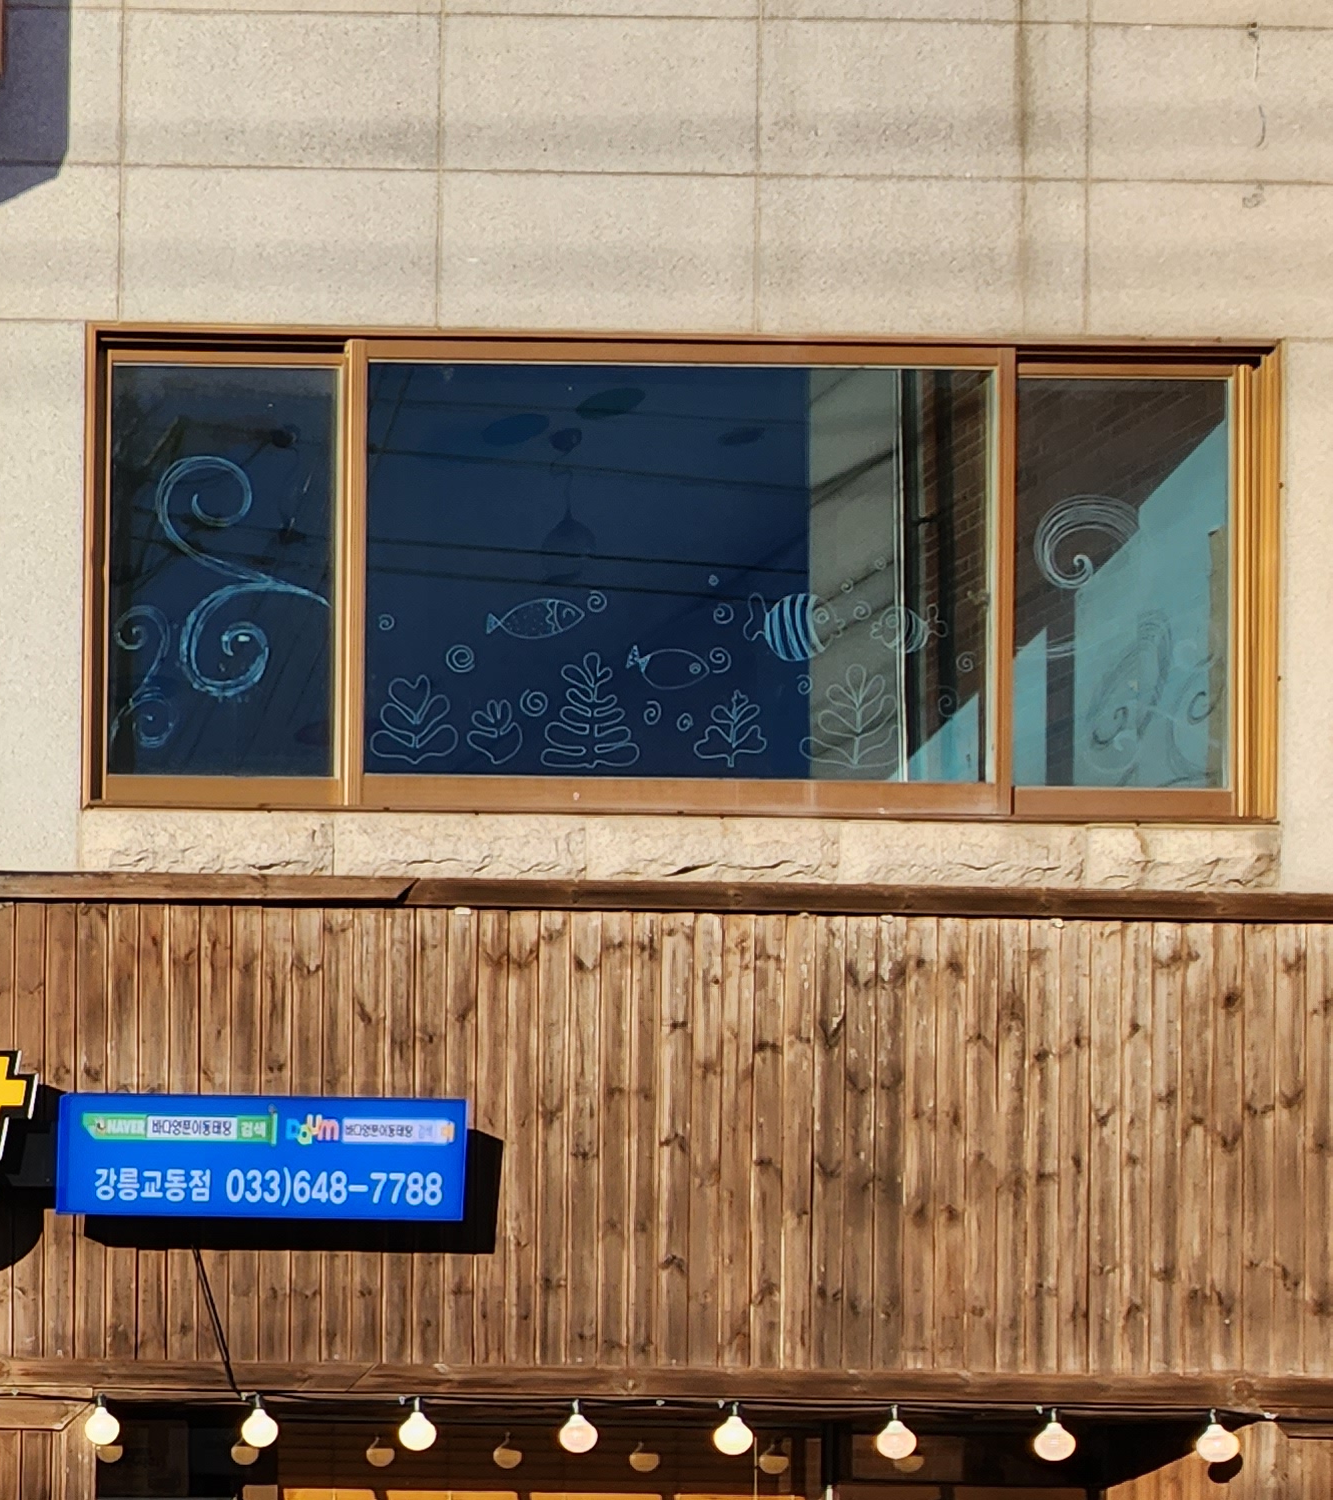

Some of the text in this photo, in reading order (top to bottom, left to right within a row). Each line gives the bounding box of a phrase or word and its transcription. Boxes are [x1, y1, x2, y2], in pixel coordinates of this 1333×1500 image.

[105, 1119, 145, 1135] NAVER
[240, 1121, 266, 1138] 검색
[286, 1113, 339, 1144] Daum
[94, 1168, 443, 1206] 강릉교동점 033)648-7788
